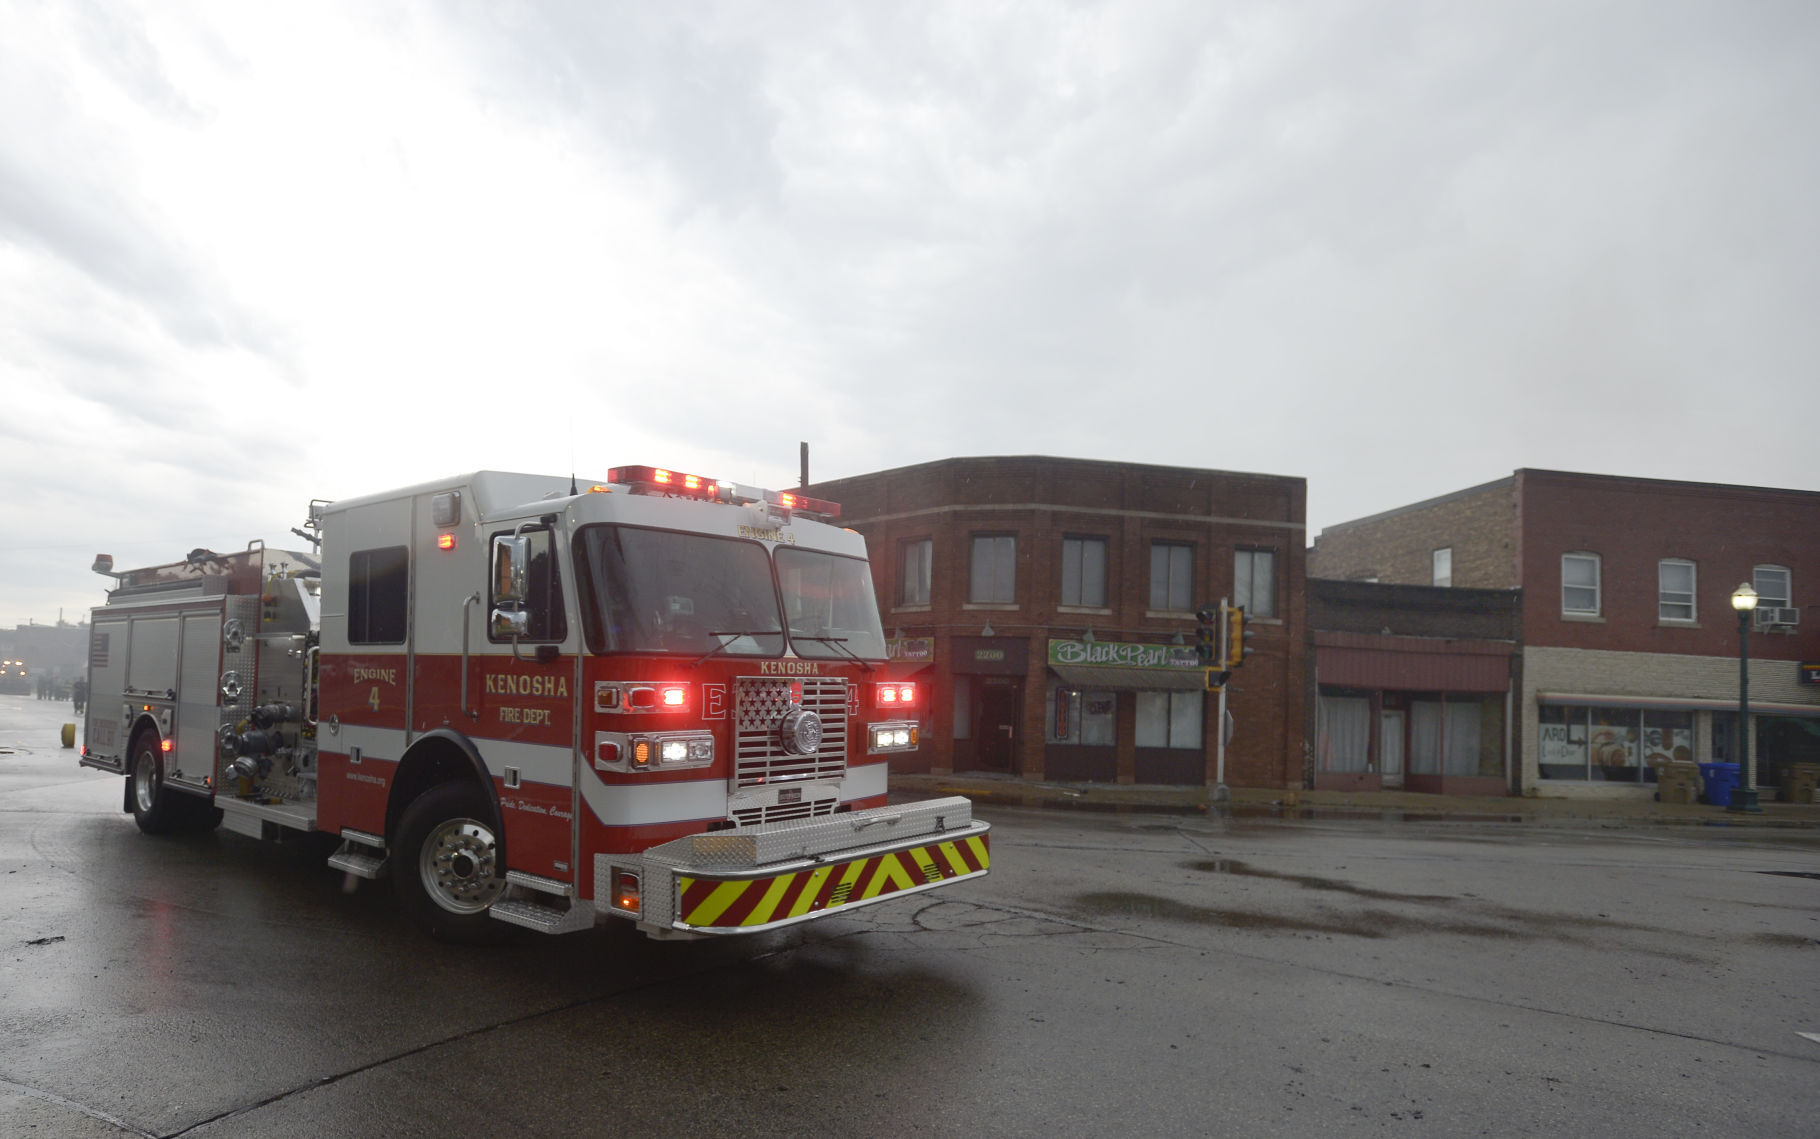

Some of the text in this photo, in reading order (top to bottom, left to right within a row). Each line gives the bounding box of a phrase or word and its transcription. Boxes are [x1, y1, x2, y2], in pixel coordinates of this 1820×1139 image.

[737, 524, 796, 546] ENGINE 4
[1056, 641, 1168, 667] Black Pearl
[353, 668, 397, 687] ENGINE
[760, 661, 819, 675] KENOSHA
[485, 673, 569, 698] KENOSHA
[367, 686, 381, 713] 4
[499, 706, 521, 723] FIRE
